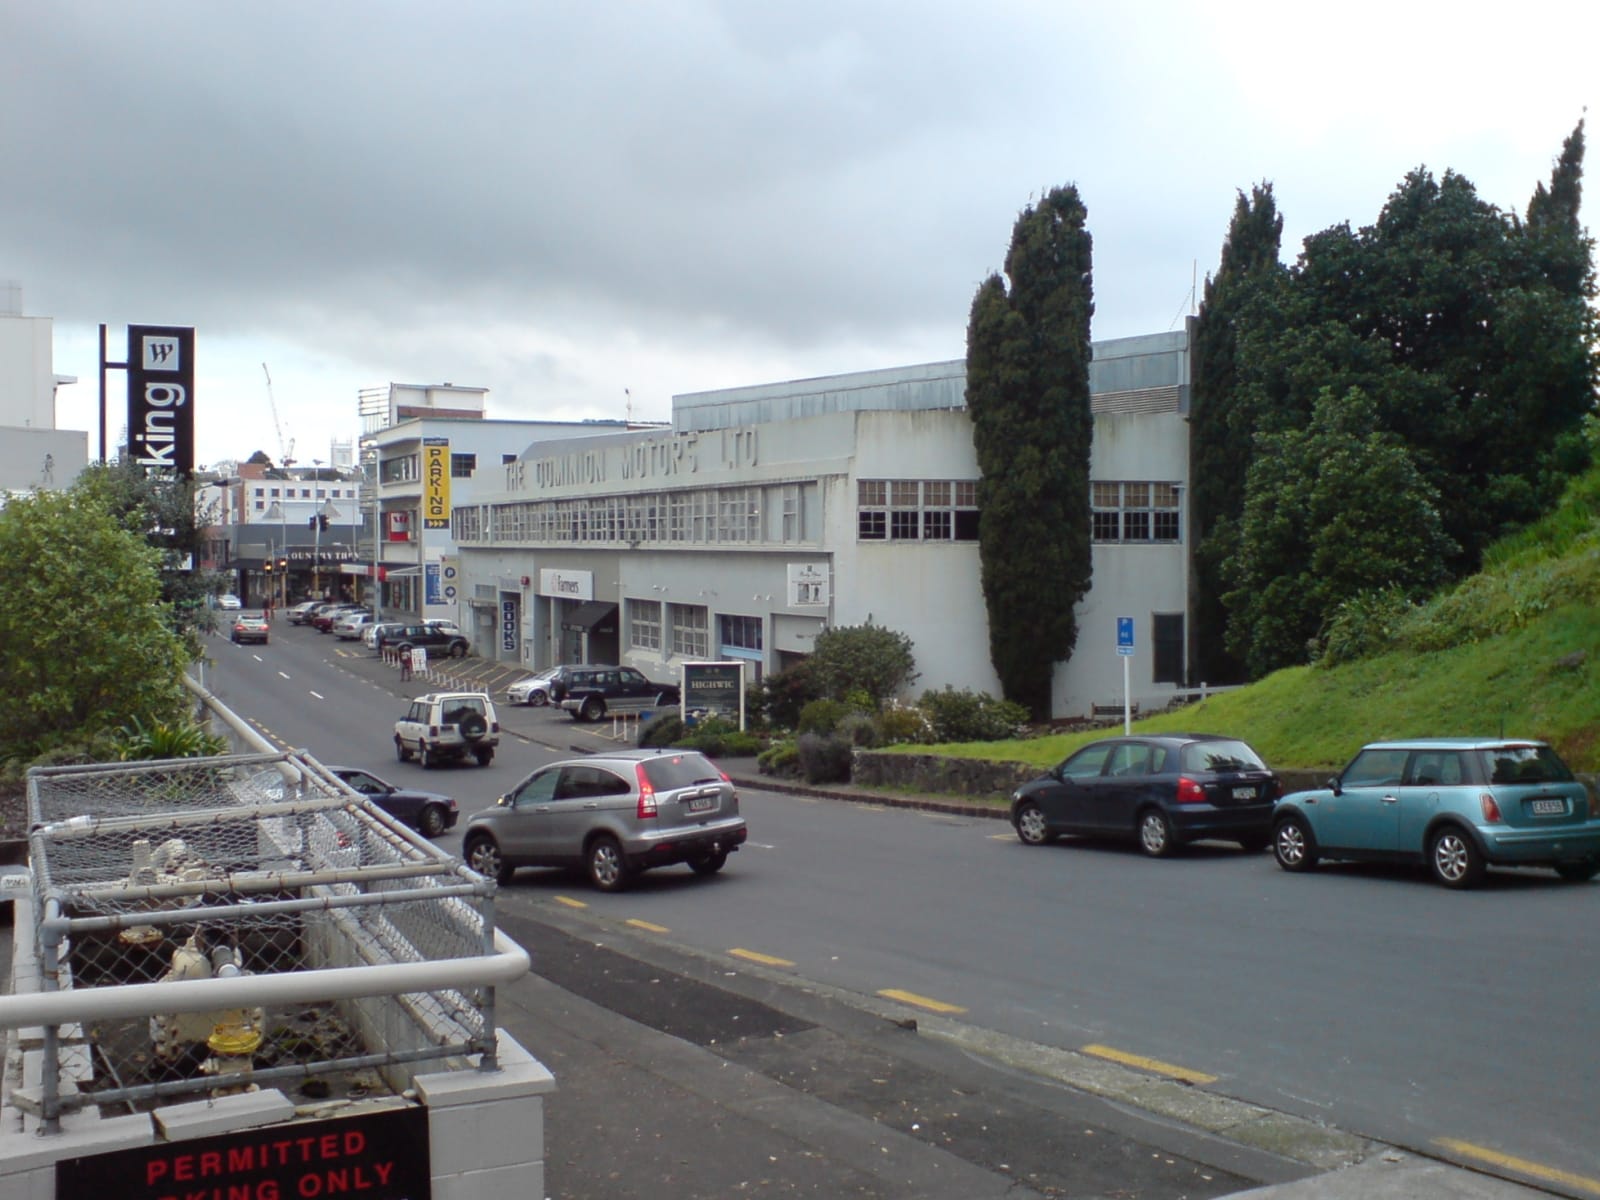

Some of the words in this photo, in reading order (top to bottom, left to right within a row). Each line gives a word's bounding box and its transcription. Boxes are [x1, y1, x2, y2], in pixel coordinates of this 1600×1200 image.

[430, 448, 443, 515] PARKING
[505, 461, 526, 492] THE
[536, 450, 607, 489] DOMINION
[621, 433, 698, 481] MOTORS
[503, 601, 515, 651] BOOKS
[691, 680, 735, 689] HIGHWIC
[146, 1131, 367, 1186] PERMITTED
[299, 1161, 394, 1198] ONLY
